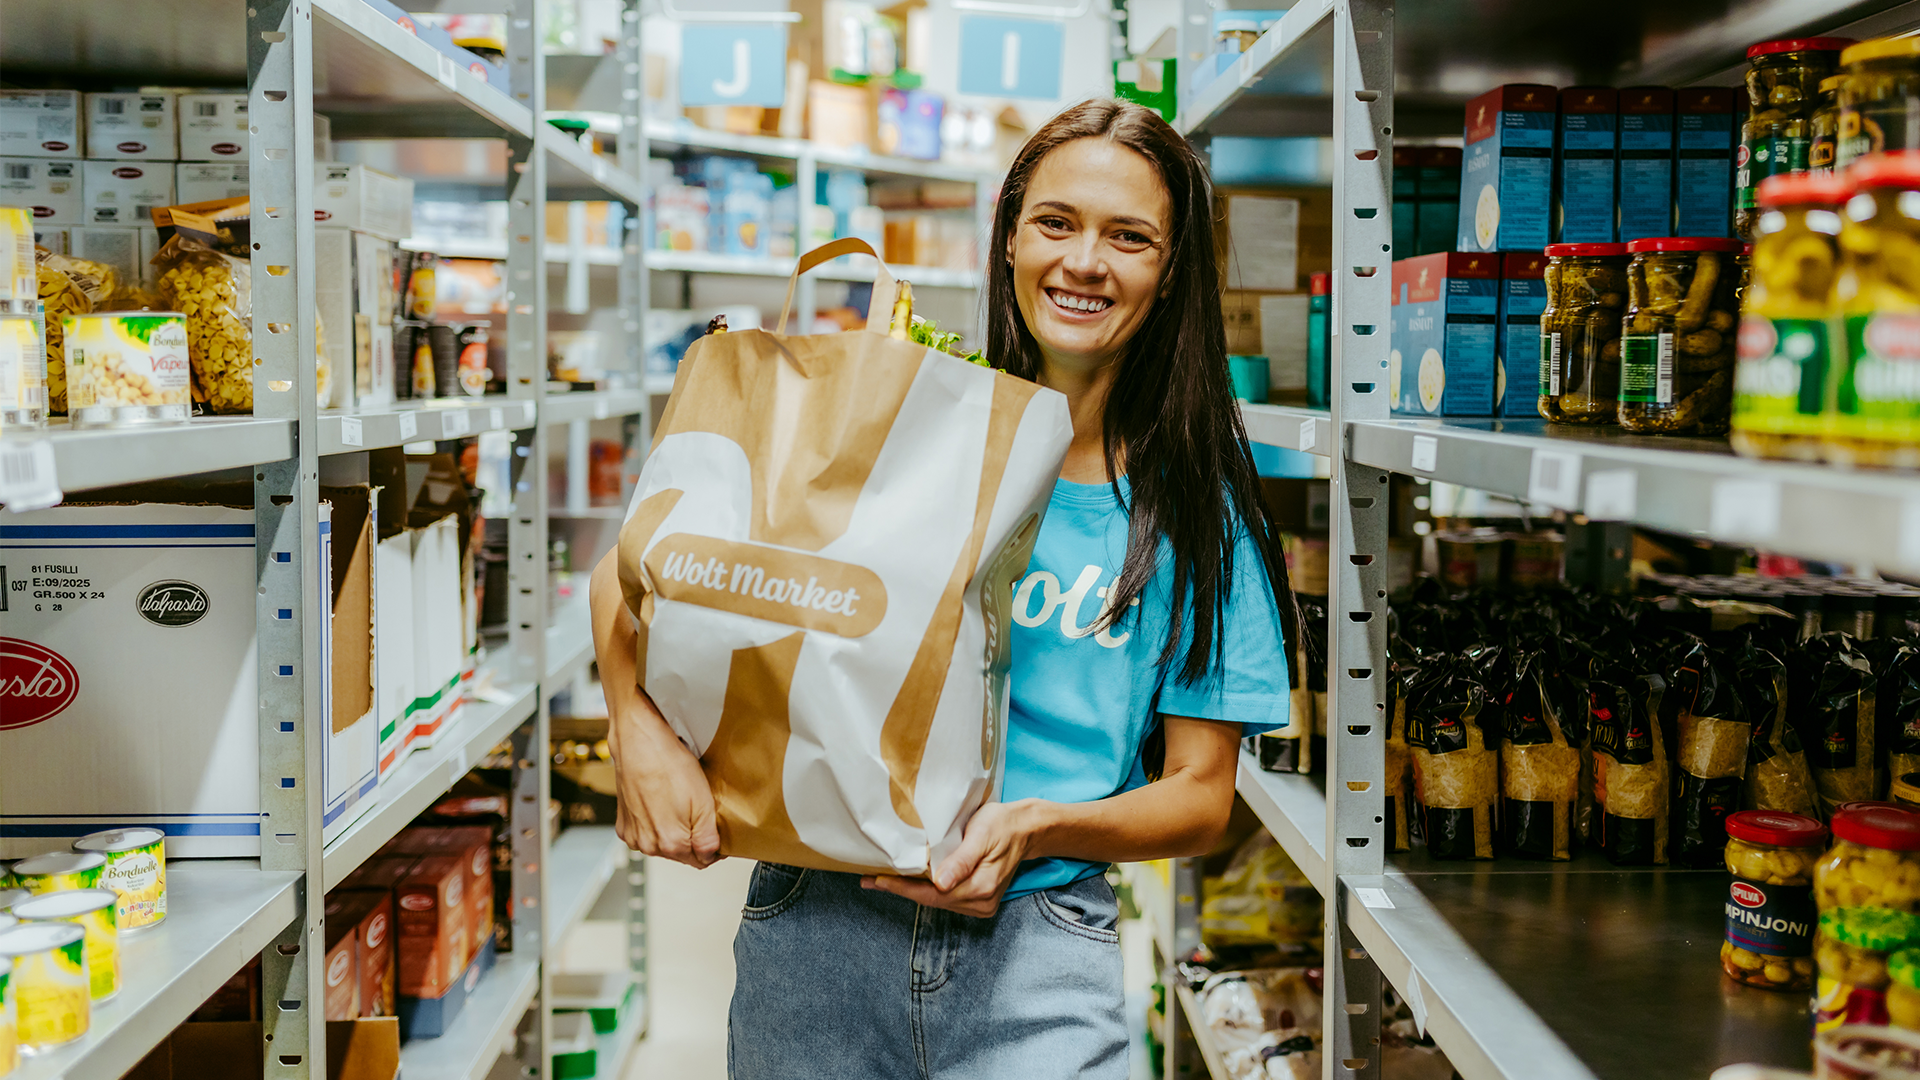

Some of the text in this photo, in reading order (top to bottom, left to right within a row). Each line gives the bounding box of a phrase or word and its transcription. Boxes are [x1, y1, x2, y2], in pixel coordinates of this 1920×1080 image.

[712, 39, 750, 98] J
[1002, 32, 1021, 89] I
[31, 565, 78, 574] 81 FUSILLI
[11, 580, 28, 591] 037
[32, 578, 91, 588] E:09/2025
[661, 551, 861, 617] Wolt Market
[33, 590, 105, 600] GR.500 X 24
[140, 586, 207, 618] italpasta
[1012, 564, 1140, 649] olt
[108, 860, 158, 880] Bonduelle
[1731, 885, 1760, 904] SPILVA
